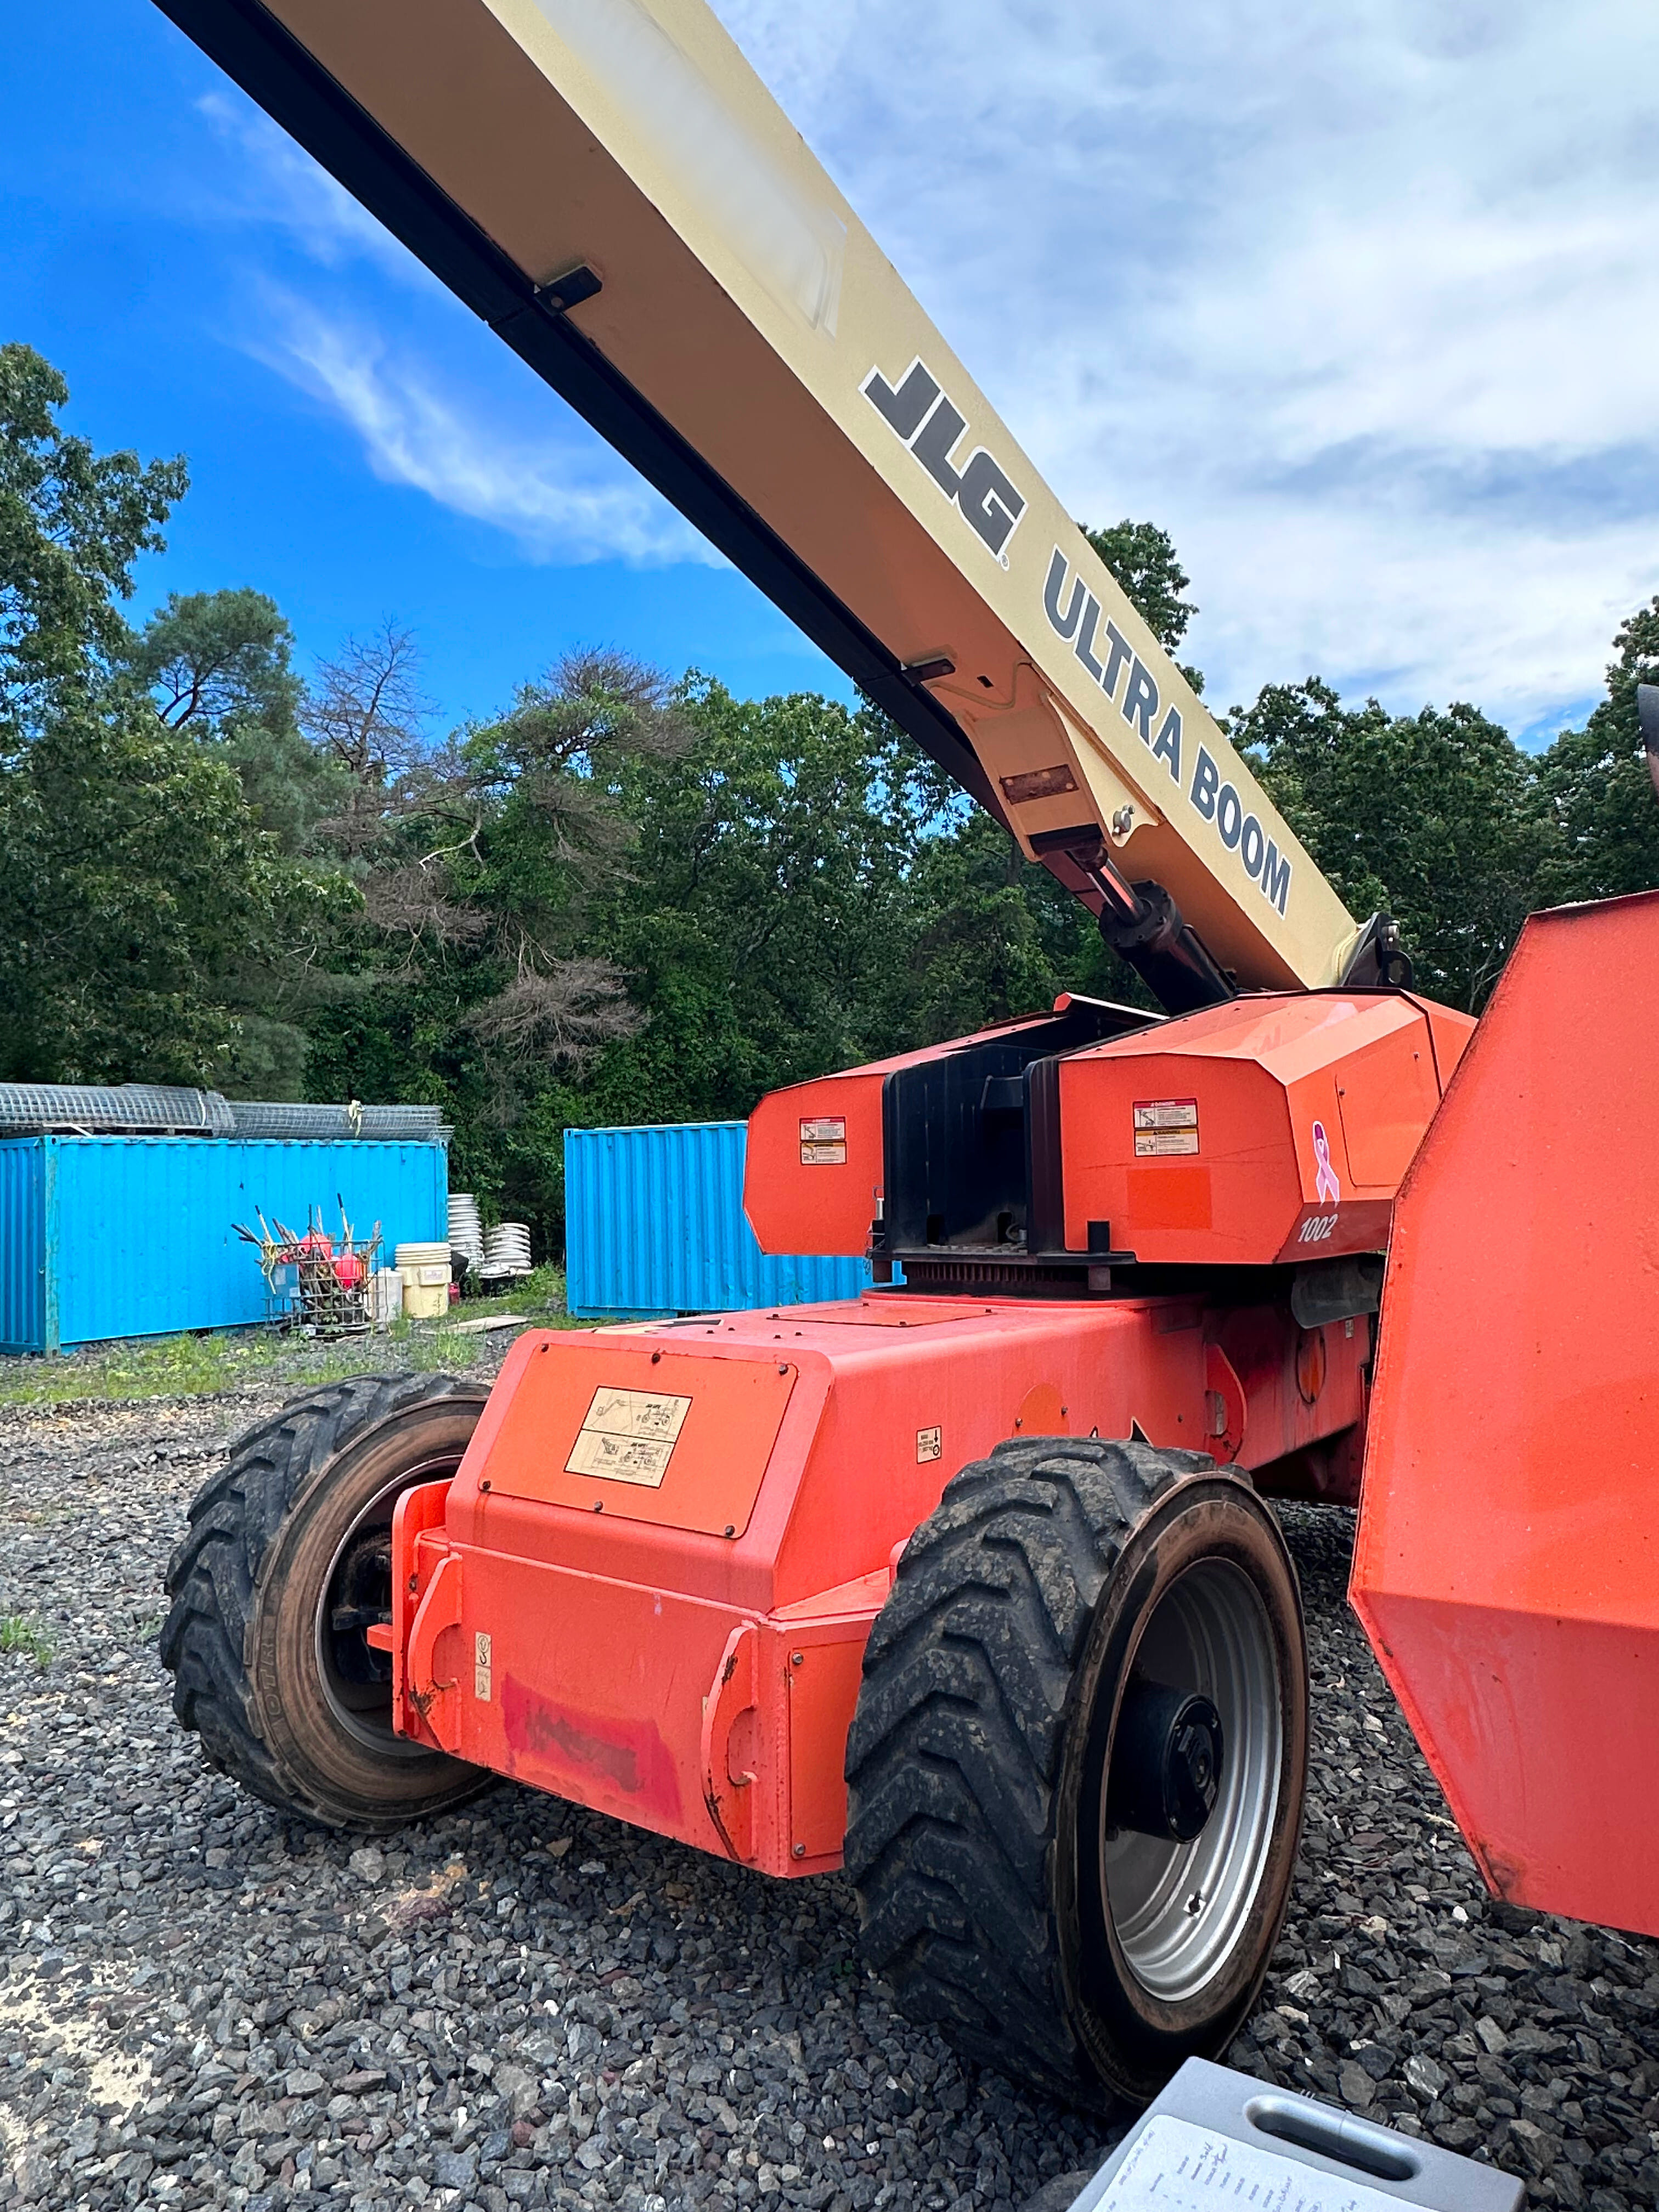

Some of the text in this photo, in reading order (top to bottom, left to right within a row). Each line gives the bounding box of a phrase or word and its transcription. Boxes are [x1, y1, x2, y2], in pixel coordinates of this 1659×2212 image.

[859, 356, 1028, 561] JLG
[1043, 544, 1293, 920] ULTRA BOOM
[1297, 1214, 1338, 1242] 1002
[260, 1643, 281, 1716] OTR
